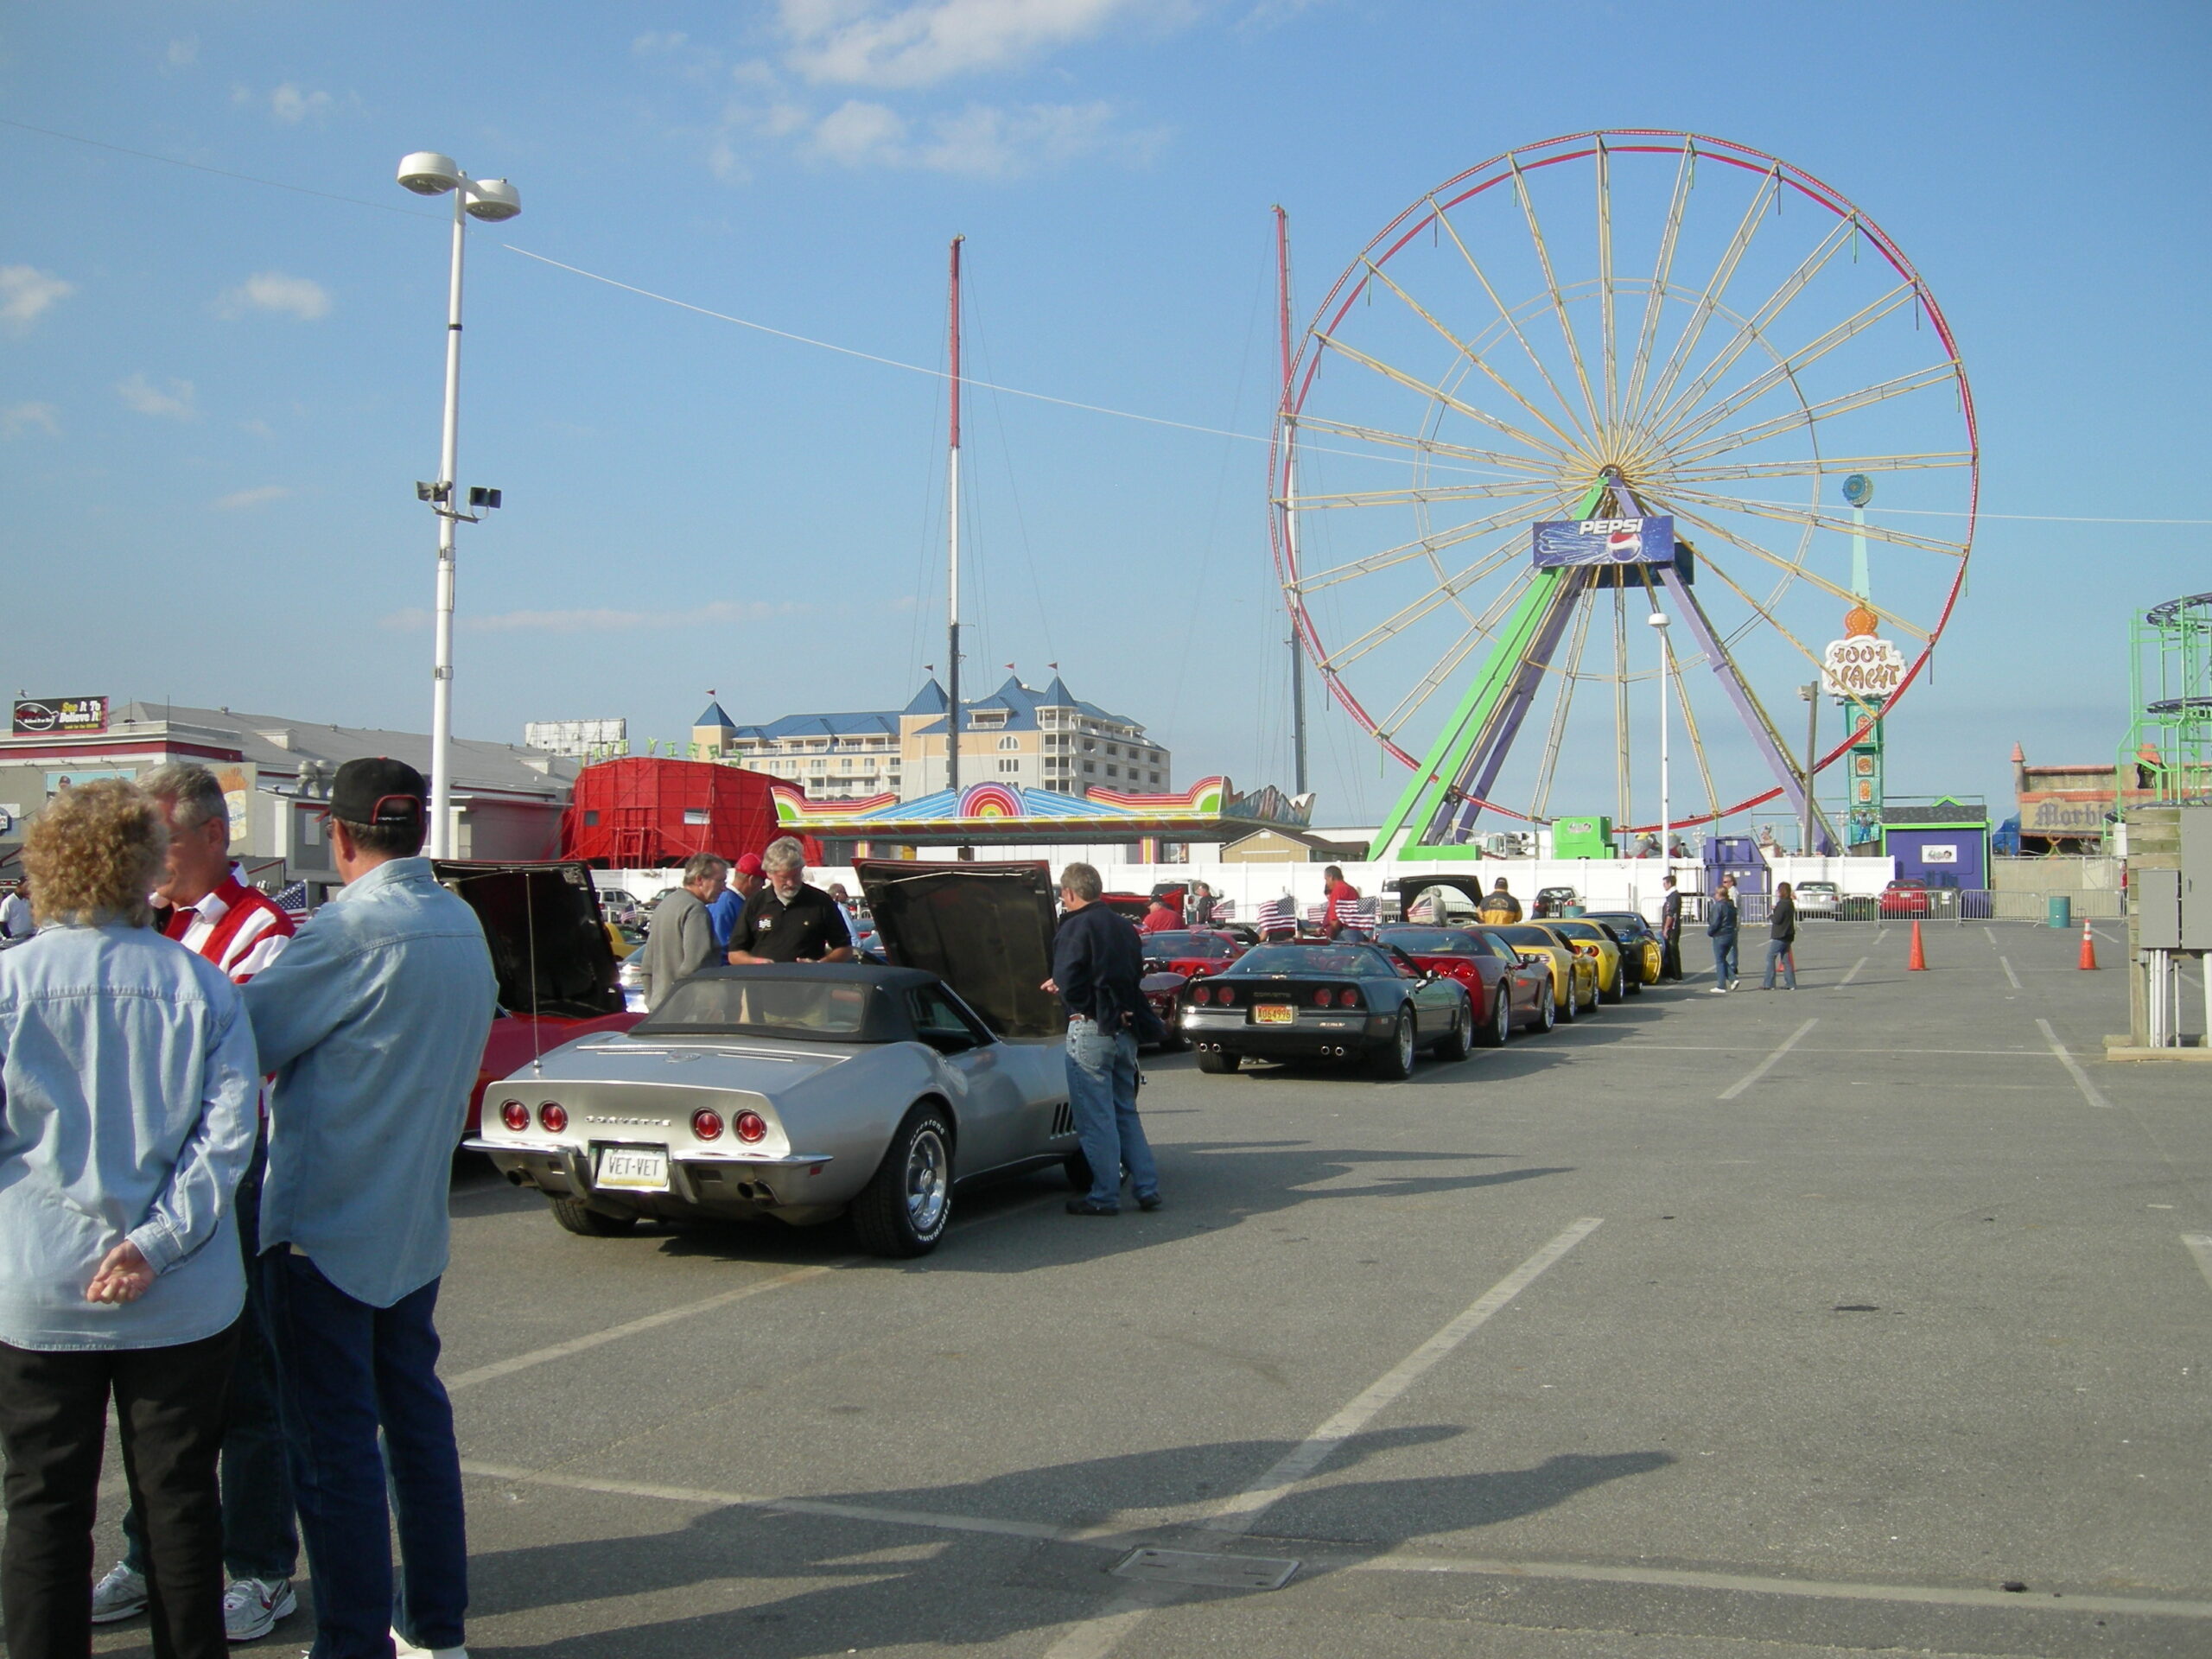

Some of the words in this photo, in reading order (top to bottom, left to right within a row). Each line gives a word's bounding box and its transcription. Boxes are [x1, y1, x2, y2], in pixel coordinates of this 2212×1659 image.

[1579, 518, 1644, 535] PEPSI
[1834, 645, 1887, 664] 1001
[61, 702, 78, 712] See
[79, 701, 87, 712] It
[90, 700, 101, 711] To
[59, 712, 90, 723] Believe
[2033, 802, 2118, 827] Morbi
[585, 1115, 671, 1127] CORVETTE
[609, 1156, 660, 1176] VET-VET
